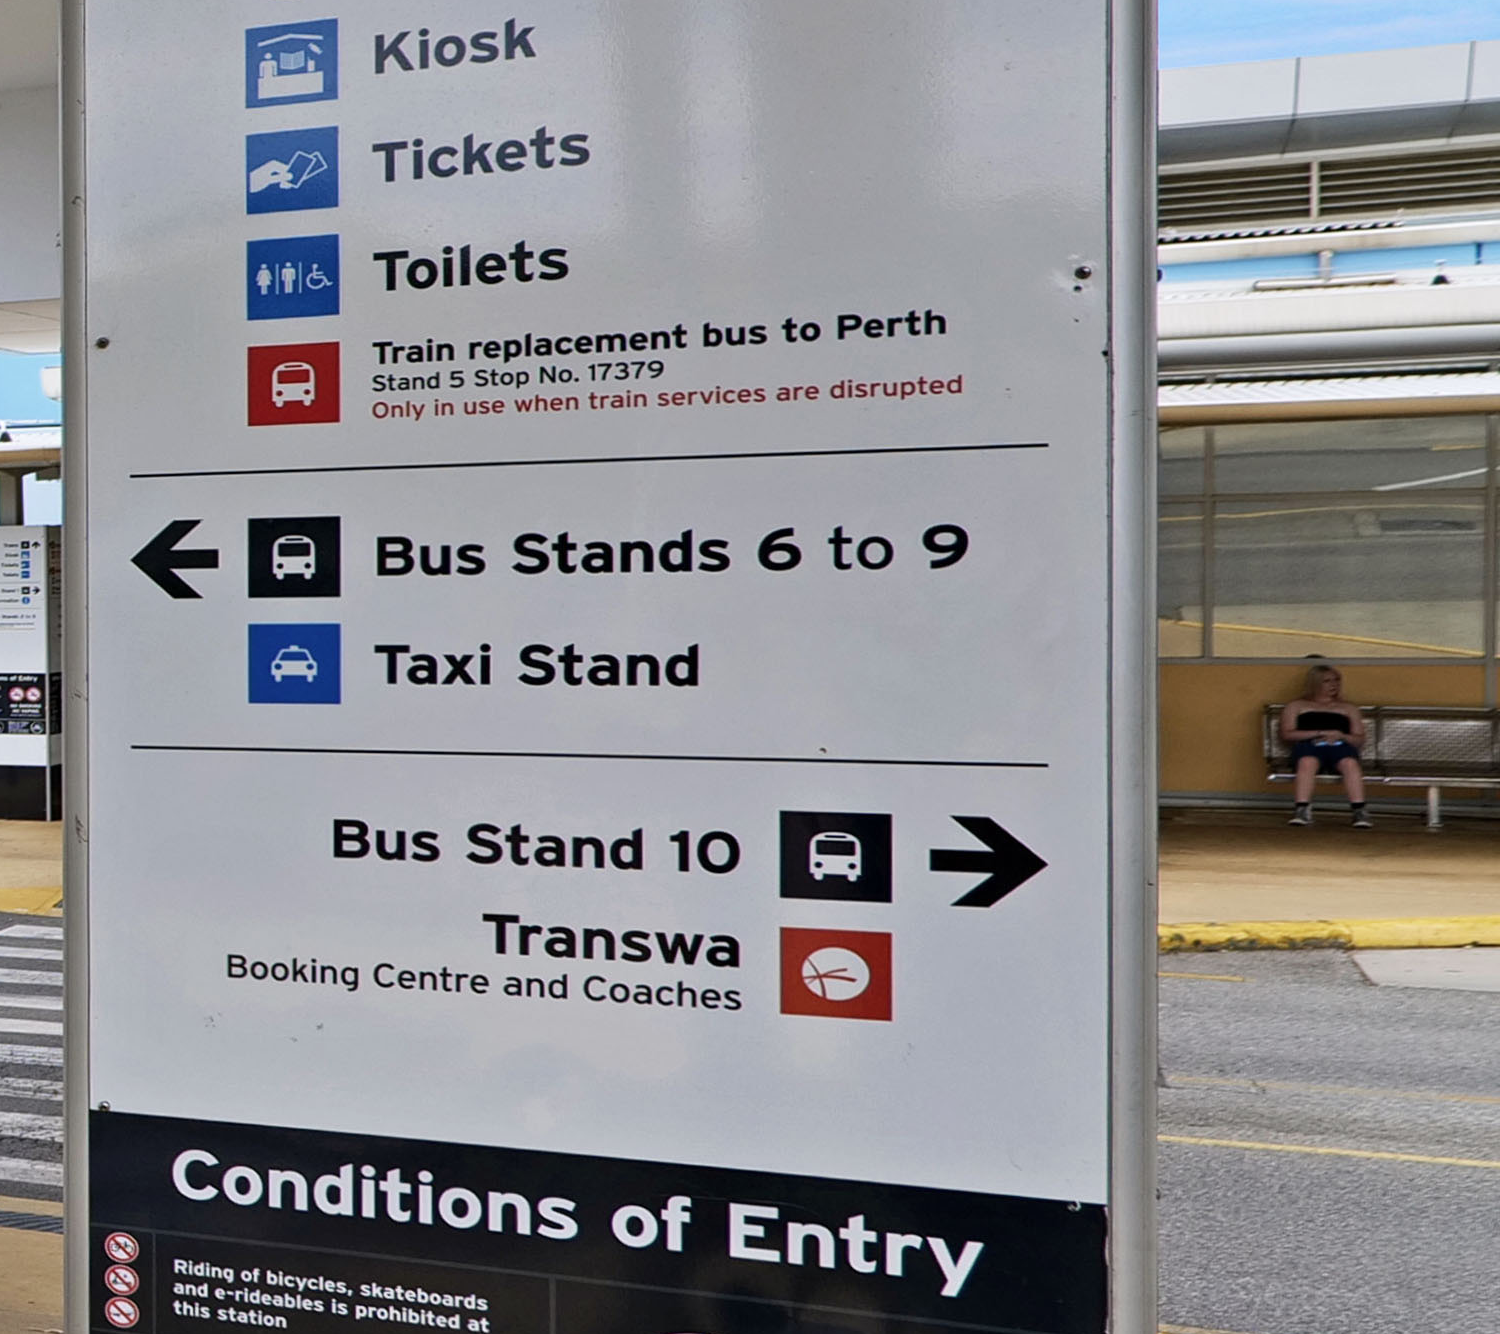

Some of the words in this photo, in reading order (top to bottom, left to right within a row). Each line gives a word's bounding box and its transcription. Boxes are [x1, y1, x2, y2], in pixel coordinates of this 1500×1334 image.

[375, 18, 536, 74] Kiosk
[372, 126, 590, 182] Tickets
[373, 240, 569, 291] Toilets
[372, 338, 454, 364] Train
[469, 324, 687, 363] replacement
[703, 322, 767, 347] bus
[781, 318, 821, 343] to
[837, 309, 946, 340] Perth
[372, 372, 440, 392] Stand
[450, 370, 465, 388] 5
[474, 369, 529, 389] Stop
[539, 366, 579, 384] No.
[588, 360, 664, 381] 17379
[372, 401, 425, 421] Only
[434, 399, 454, 416] in
[464, 400, 505, 415] use
[514, 394, 579, 412] when
[588, 390, 647, 410] train
[657, 386, 766, 407] services
[776, 386, 820, 402] are
[830, 374, 962, 400] disrupted
[377, 536, 486, 576] Bus
[512, 529, 730, 574] Stands
[758, 527, 802, 571] 6
[828, 526, 894, 570] to
[922, 524, 968, 569] 9
[374, 643, 491, 685] Taxi
[518, 644, 699, 687] Stand
[333, 819, 440, 862] Bus
[466, 823, 643, 870] Stand
[670, 830, 740, 874] 10
[482, 913, 740, 968] Transwa
[227, 954, 359, 992] Booking
[373, 963, 489, 994] Centre
[503, 974, 568, 999] and
[583, 975, 742, 1011] Coaches
[172, 1149, 578, 1239] Conditions
[612, 1196, 691, 1251] of
[729, 1203, 984, 1297] Entry
[173, 1283, 208, 1298] and
[214, 1288, 324, 1312] e-rideables
[331, 1298, 348, 1315] is
[355, 1305, 460, 1329] prohibited
[467, 1317, 490, 1333] at
[174, 1259, 234, 1283] Riding
[240, 1268, 260, 1283] of
[266, 1270, 353, 1296] bicycles,
[360, 1282, 488, 1311] skateboards
[173, 1300, 210, 1318] this
[217, 1307, 287, 1328] station
